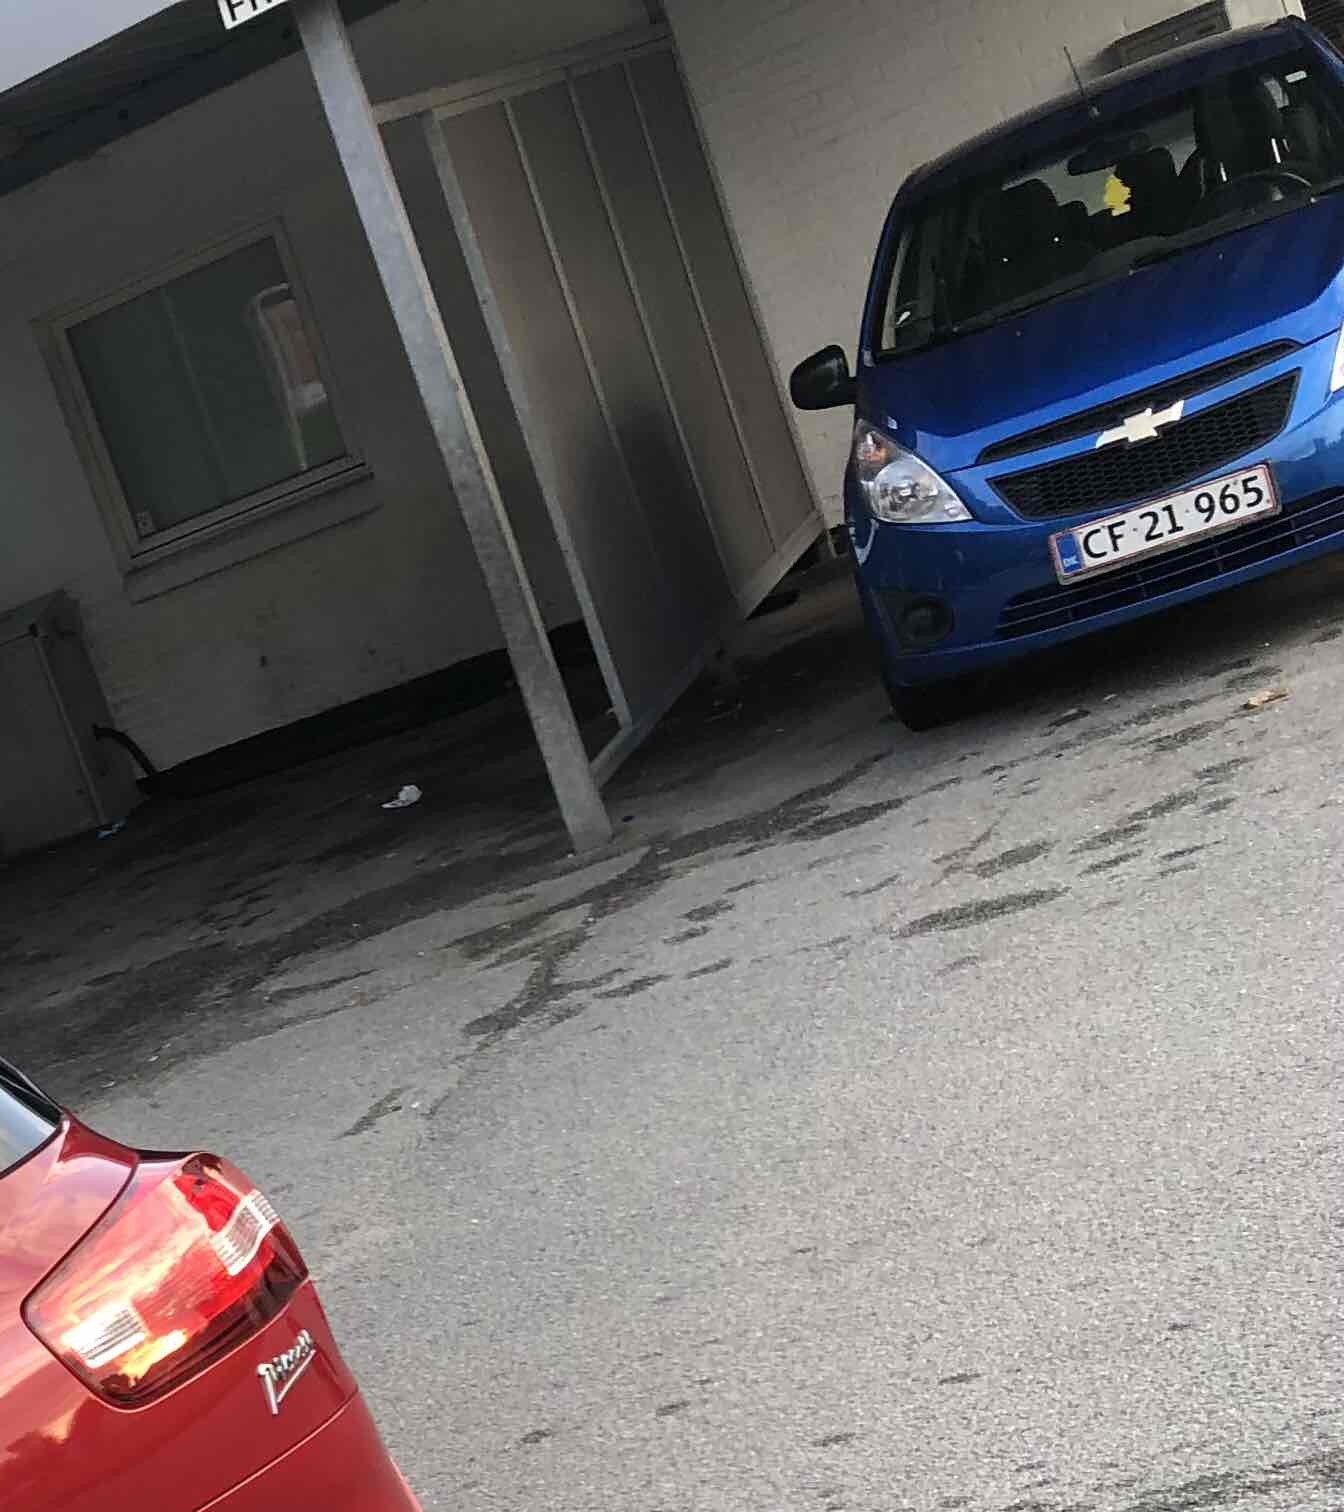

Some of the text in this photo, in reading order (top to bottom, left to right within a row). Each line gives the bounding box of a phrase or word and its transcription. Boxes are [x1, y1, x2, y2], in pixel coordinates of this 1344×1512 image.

[1082, 475, 1264, 559] CF 21 965
